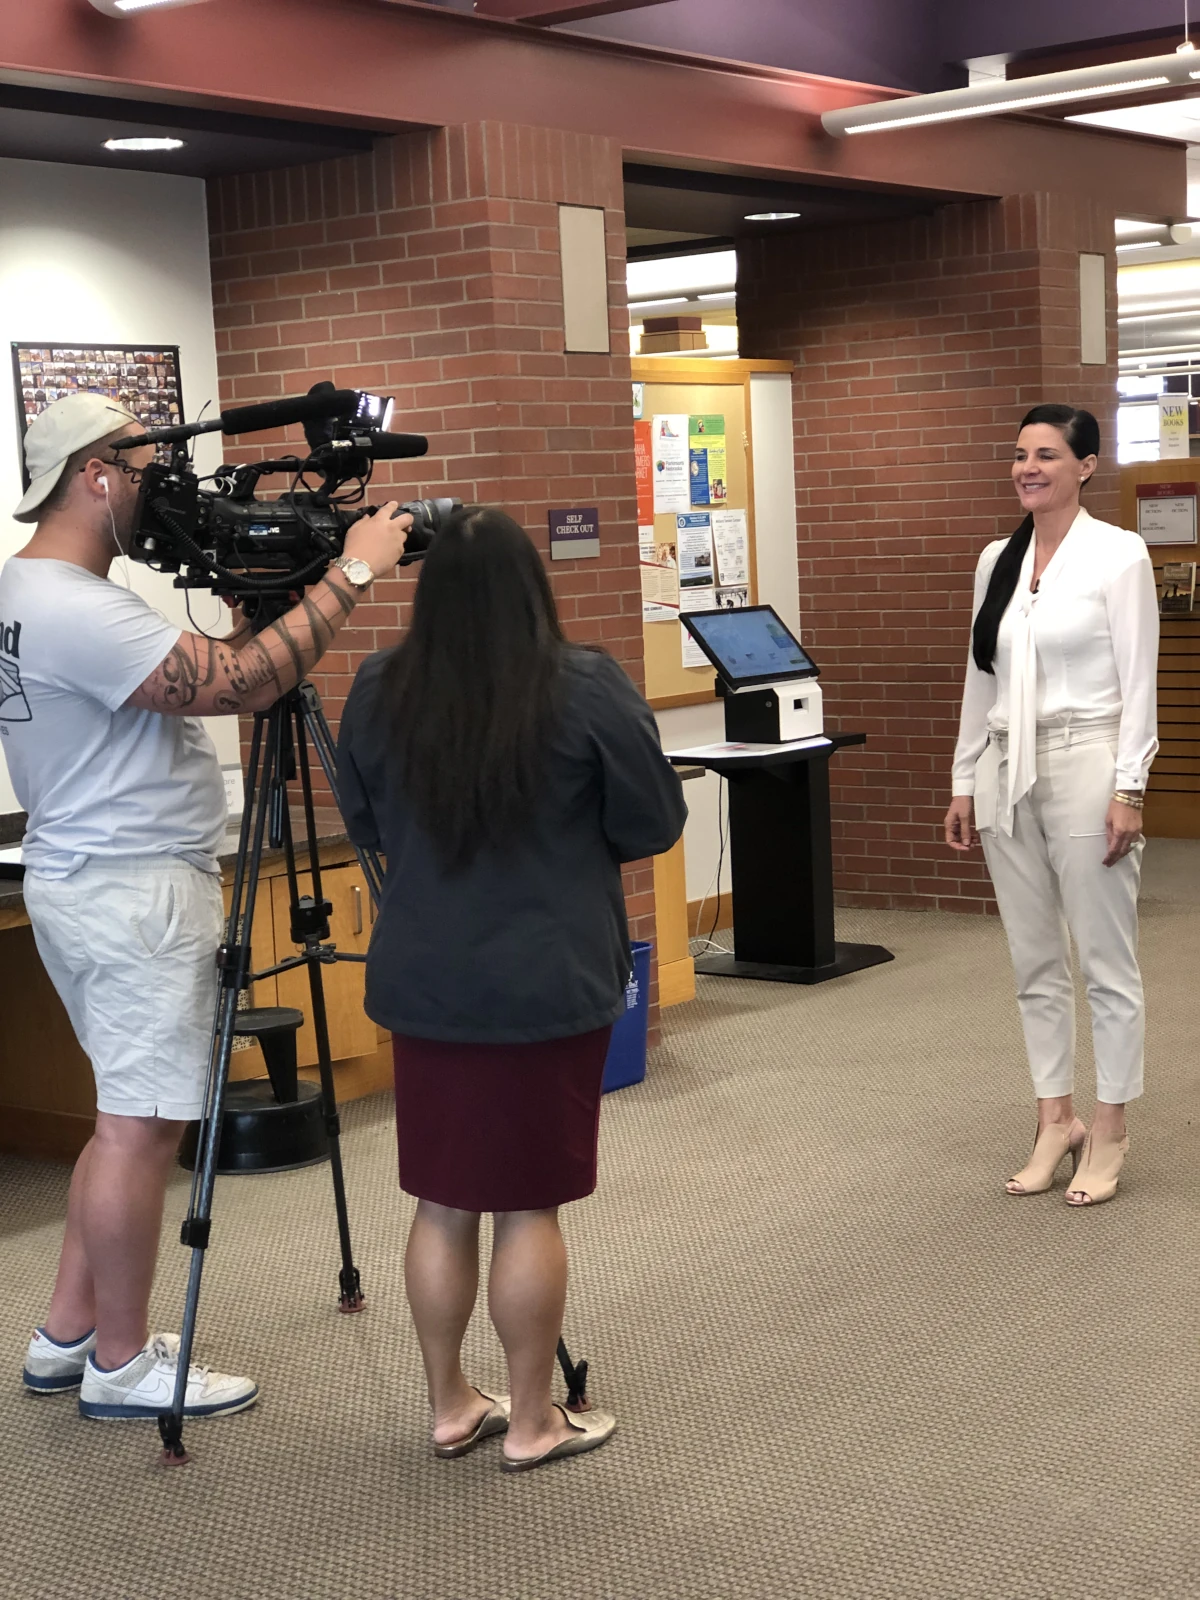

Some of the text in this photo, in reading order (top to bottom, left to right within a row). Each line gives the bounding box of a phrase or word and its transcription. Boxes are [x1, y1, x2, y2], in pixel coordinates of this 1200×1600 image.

[1162, 405, 1183, 417] NEW
[1163, 419, 1184, 427] BOOKS
[566, 514, 583, 524] SELF
[267, 526, 280, 534] JVC
[556, 524, 594, 534] CHECK OUT
